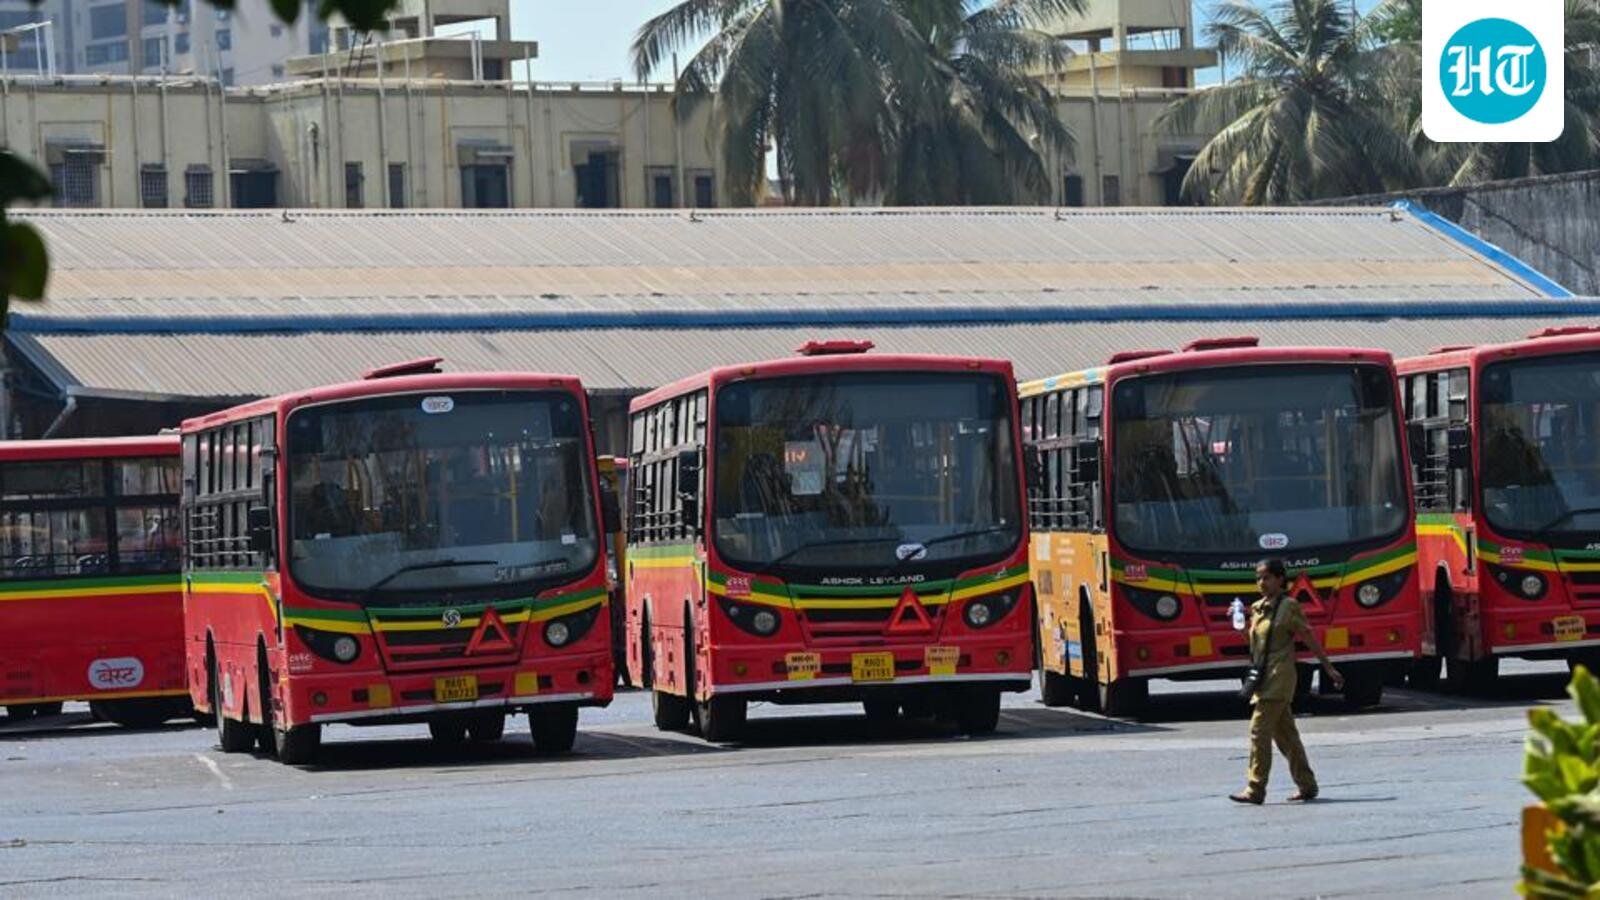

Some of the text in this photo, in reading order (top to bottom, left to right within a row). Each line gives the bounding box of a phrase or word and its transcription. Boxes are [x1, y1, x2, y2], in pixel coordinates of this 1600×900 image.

[821, 574, 925, 585] ASHOK LEYLAND
[95, 662, 137, 685] बेस्ट
